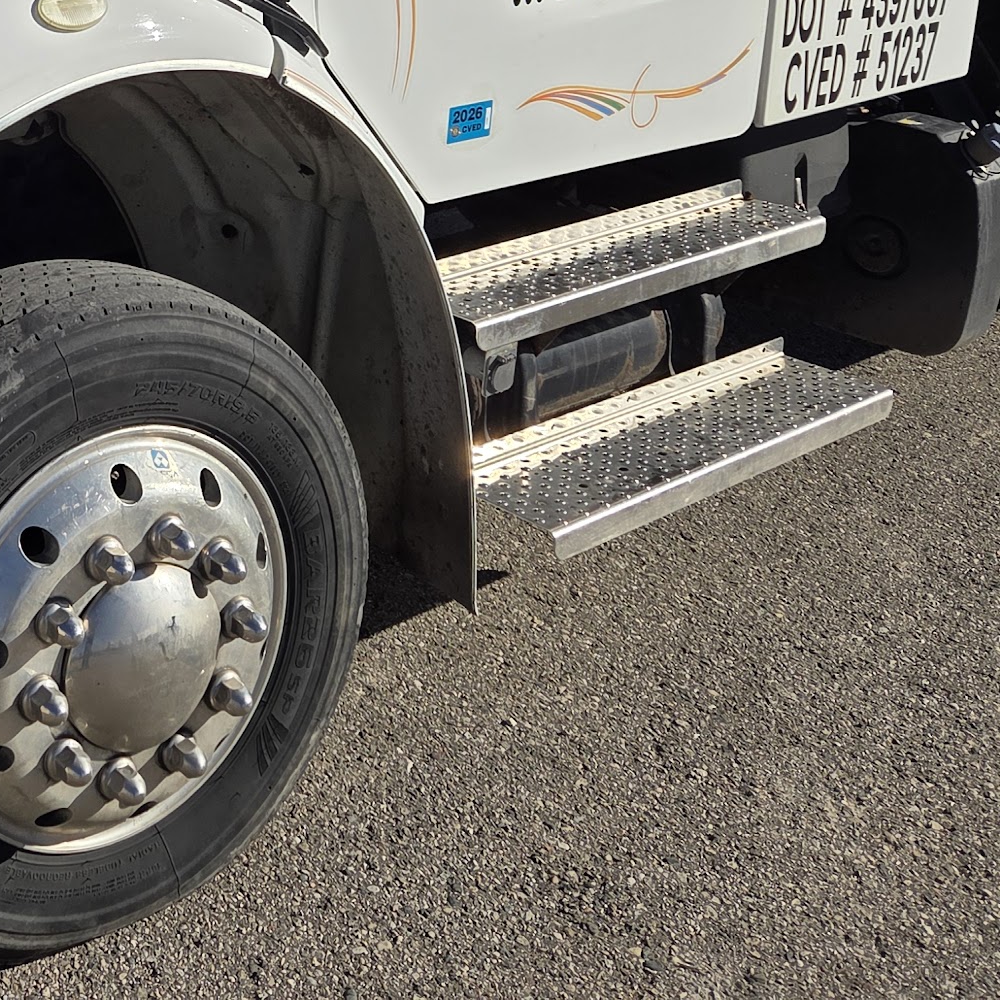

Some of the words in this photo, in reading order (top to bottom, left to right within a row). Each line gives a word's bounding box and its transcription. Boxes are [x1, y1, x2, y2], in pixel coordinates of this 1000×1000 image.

[784, 43, 846, 114] CVED
[851, 34, 872, 98] #
[876, 21, 939, 92] 51237
[452, 106, 483, 124] 2026
[462, 123, 481, 133] CVED
